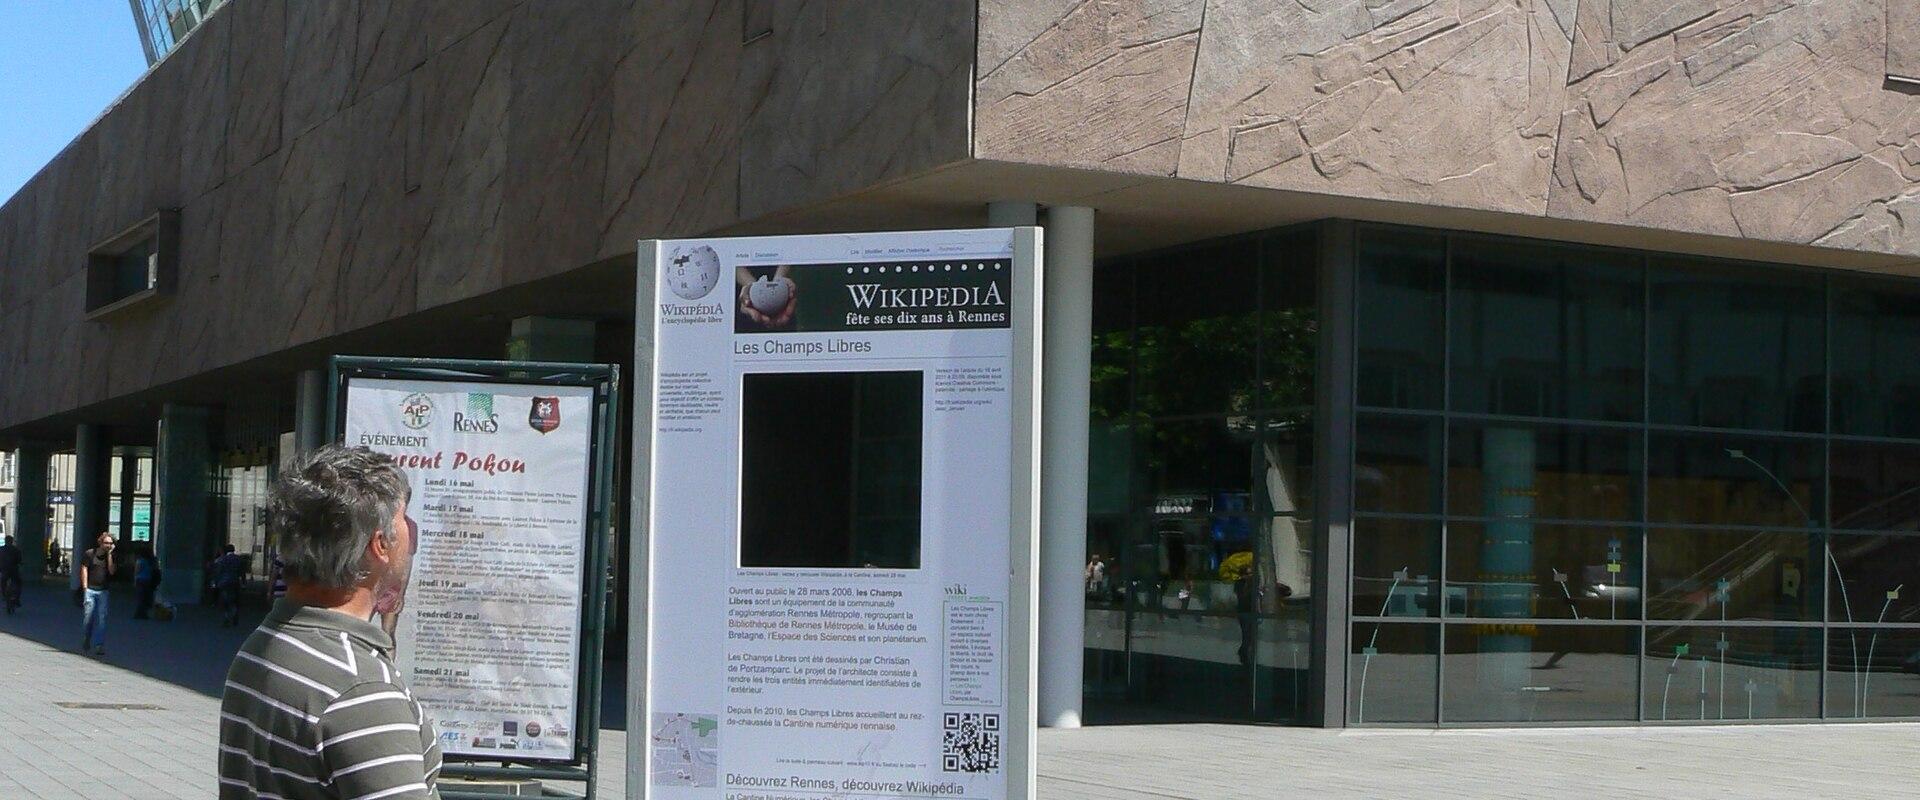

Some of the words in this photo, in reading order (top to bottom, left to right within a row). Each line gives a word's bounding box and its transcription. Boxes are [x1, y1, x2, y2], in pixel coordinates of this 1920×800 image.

[846, 311, 872, 325] fête
[875, 314, 894, 324] ses
[897, 311, 918, 324] dix
[921, 313, 942, 323] ans
[946, 311, 955, 322] à
[958, 310, 1005, 323] Rennes
[734, 340, 758, 354] Les
[765, 340, 823, 357] Champs
[828, 339, 872, 353] Libres
[360, 431, 428, 447] ÉVÉNEMENT
[425, 478, 447, 486] Lundi
[460, 480, 475, 488] mai
[423, 503, 446, 512] Mardi
[459, 505, 474, 513] mai
[421, 529, 457, 538] Mercredi
[470, 531, 485, 540] mai
[418, 579, 439, 588] Jeudi
[452, 581, 467, 589] mai
[944, 584, 968, 595] wiki
[729, 586, 753, 596] Ouvert
[765, 587, 787, 598] public
[797, 587, 807, 596] 28
[857, 589, 867, 597] les
[870, 589, 903, 600] Champs
[755, 598, 770, 606] sont
[783, 598, 826, 608] équipement
[828, 599, 837, 607] de
[839, 599, 845, 607] la
[847, 600, 895, 608] communauté
[417, 610, 452, 619] Vendredi
[465, 612, 480, 621] mai
[728, 609, 785, 619] d'agglomération
[788, 609, 818, 618] Rennes
[864, 612, 905, 622] regroupant
[907, 612, 913, 620] la
[728, 619, 776, 630] Bibliothèque
[779, 619, 789, 628] de
[791, 620, 821, 630] Rennes
[868, 622, 875, 631] le
[877, 622, 904, 631] Musée
[906, 623, 917, 632] de
[768, 631, 801, 642] l'Espace
[803, 632, 818, 641] des
[820, 632, 857, 642] Sciences
[858, 634, 866, 642] et
[728, 653, 741, 662] Les
[743, 653, 773, 664] Champs
[775, 655, 797, 663] Libres
[799, 655, 810, 663] ont
[812, 655, 823, 663] été
[826, 656, 857, 665] dessinés
[860, 658, 872, 667] par
[873, 656, 911, 666] Christian
[413, 666, 442, 676] Samedi
[455, 669, 470, 678] mai
[728, 664, 738, 672] de
[805, 667, 825, 676] projet
[838, 668, 878, 676] l'architecte
[880, 669, 911, 678] consiste
[913, 669, 918, 678] à
[728, 675, 750, 683] rendre
[752, 676, 763, 684] les
[765, 676, 780, 685] trois
[782, 677, 806, 685] entités
[808, 677, 865, 688] immédiatement
[866, 679, 909, 688] identifiables
[911, 680, 921, 689] de
[727, 685, 764, 694] l'extérieur.
[727, 705, 752, 716] Depuis
[754, 706, 763, 714] fin
[764, 706, 785, 716] 2010,
[787, 707, 797, 716] les
[799, 708, 829, 718] Champs
[832, 709, 853, 718] Libres
[855, 711, 896, 720] accueillent
[899, 712, 908, 720] au
[910, 712, 925, 721] rez-
[727, 718, 773, 728] de-chaussée
[775, 718, 781, 727] la
[783, 718, 815, 728] Cantine
[816, 720, 858, 731] numérique
[726, 773, 787, 787] Découvrez
[790, 776, 839, 792] Rennes,
[842, 778, 904, 792] découvrez
[906, 781, 965, 796] Wikipédia
